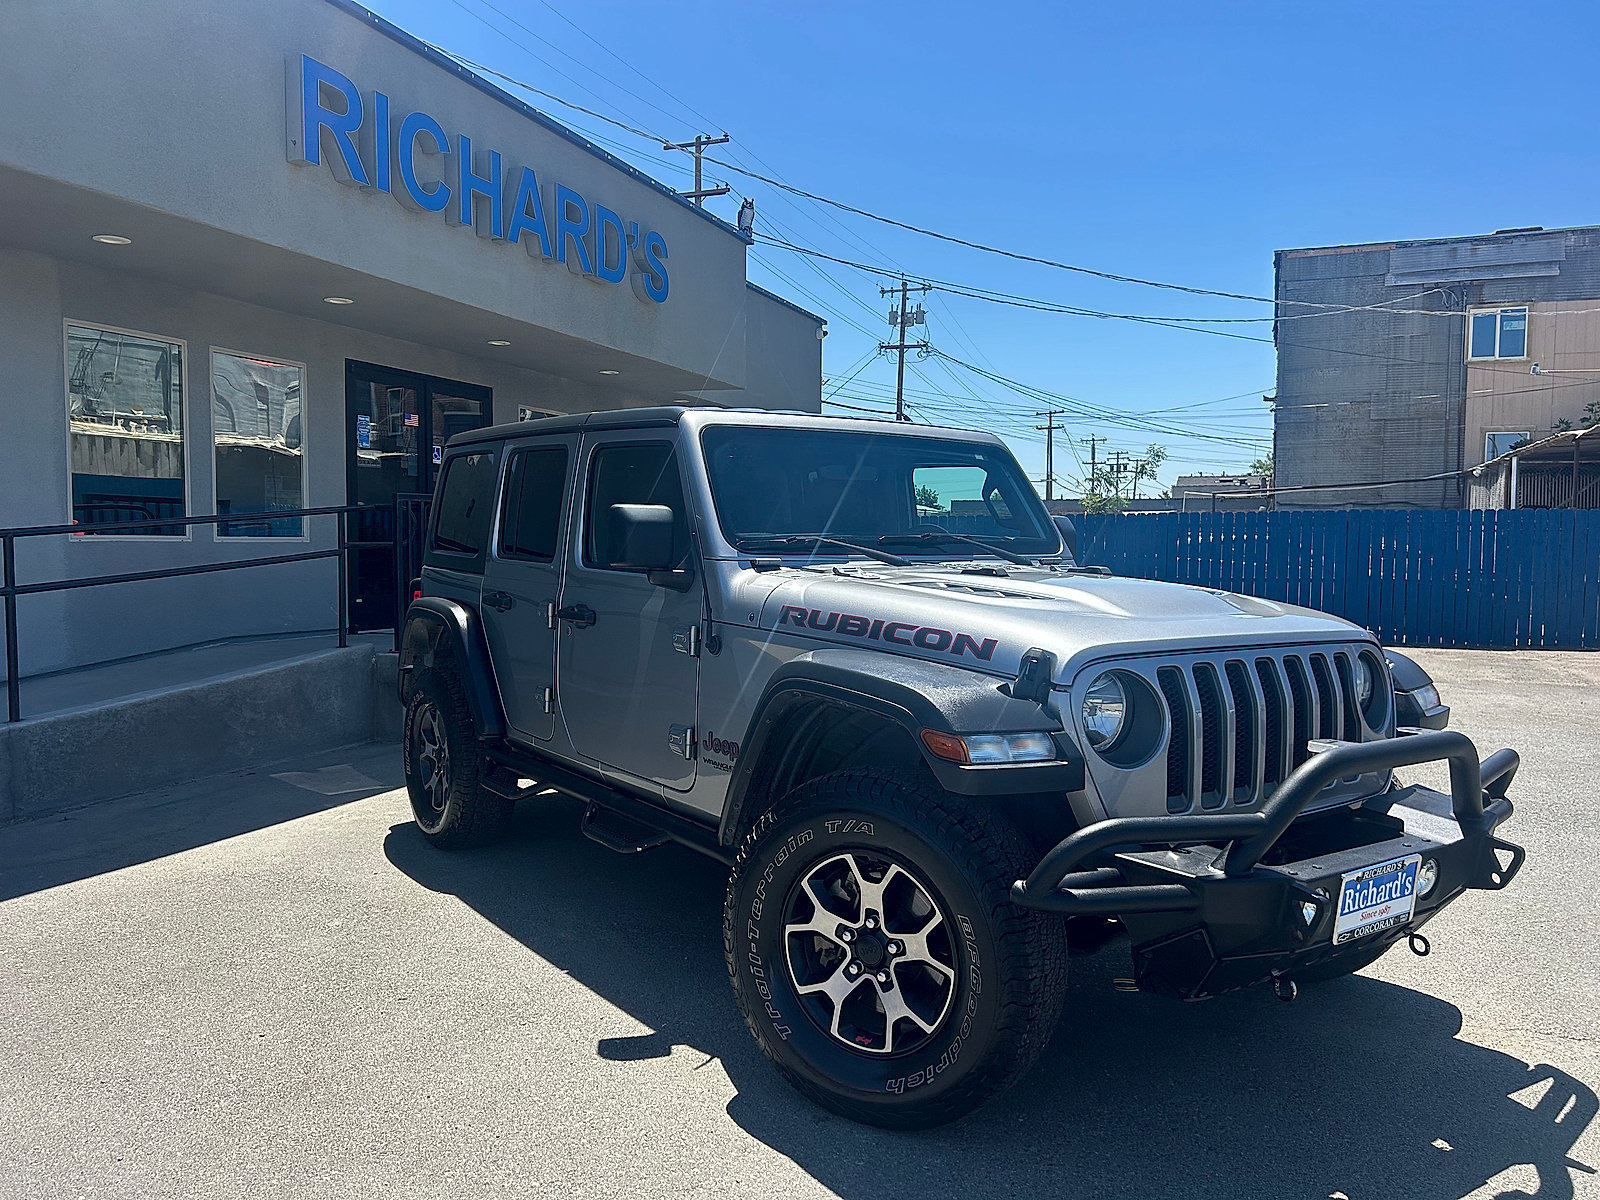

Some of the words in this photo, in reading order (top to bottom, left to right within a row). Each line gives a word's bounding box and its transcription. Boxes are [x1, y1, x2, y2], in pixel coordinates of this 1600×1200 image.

[302, 53, 670, 304] RICHARD'S
[778, 604, 998, 662] RUBICON
[703, 731, 739, 762] Jeep
[1363, 862, 1402, 879] RICHARD'S
[1343, 873, 1412, 913] Richard's
[1360, 910, 1378, 921] Since
[1379, 905, 1391, 917] 1987
[748, 829, 814, 1040] Trail-Terrain
[825, 820, 875, 836] T/A
[1354, 918, 1394, 937] CORCORAN
[886, 915, 982, 1094] BFGoodrich
